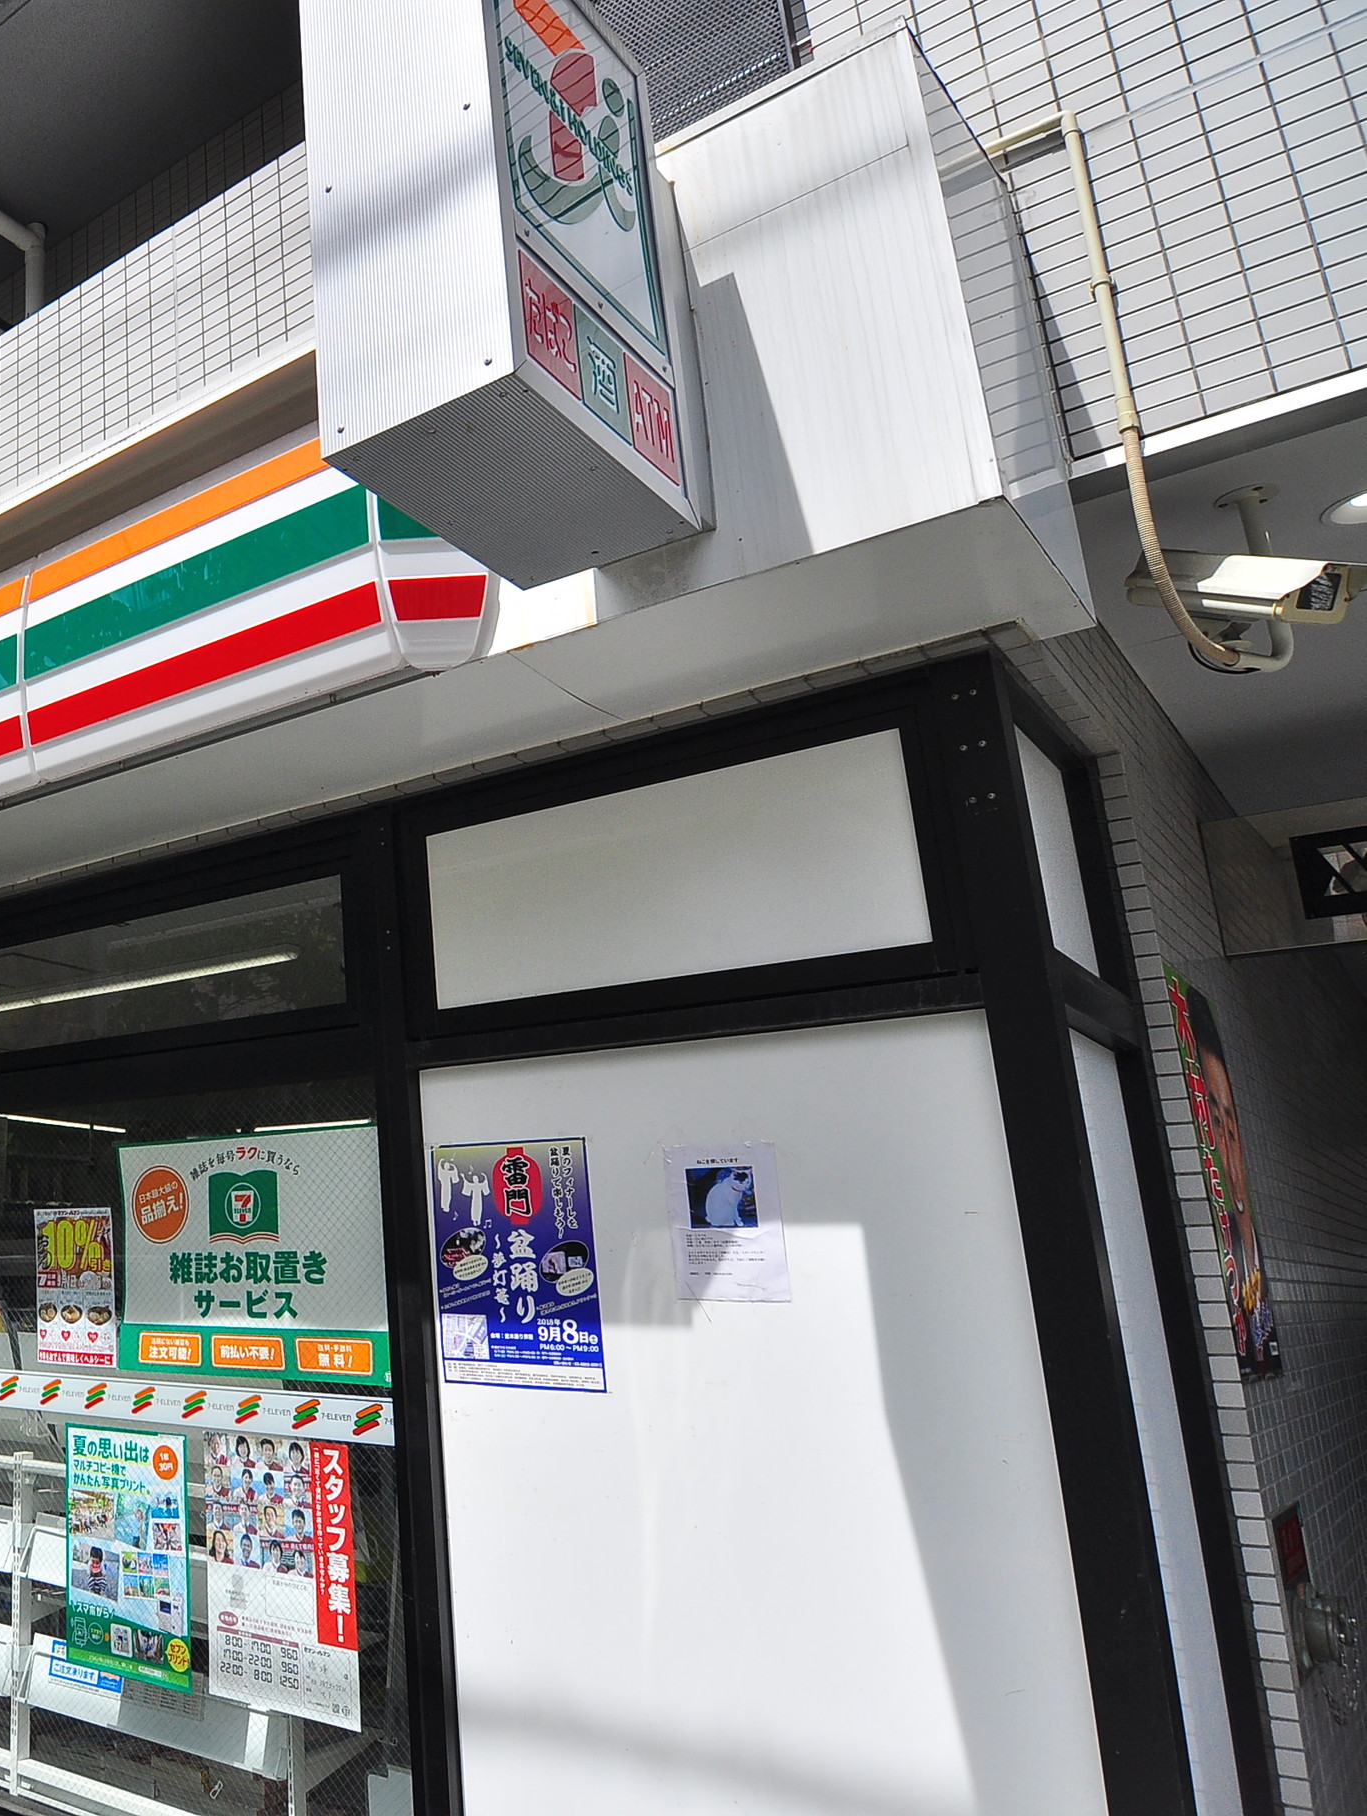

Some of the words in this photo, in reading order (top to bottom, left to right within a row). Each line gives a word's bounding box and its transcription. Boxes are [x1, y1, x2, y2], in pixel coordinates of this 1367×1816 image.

[587, 335, 620, 414] 酒
[633, 379, 675, 463] ATM
[501, 1156, 533, 1217] 雷門
[168, 1250, 329, 1285] 雑誌お取置き
[507, 1228, 539, 1325] 盆踊り
[193, 1289, 300, 1320] サービス
[537, 1318, 561, 1326] 2018年
[72, 1434, 150, 1464] 夏の思い出は
[73, 1458, 127, 1477] マルチコピー機で
[73, 1473, 151, 1495] かんたん写真プリント。
[322, 1448, 352, 1643] スタッフ募集!
[169, 1643, 187, 1655] セブン
[281, 1644, 299, 1661] 960
[280, 1660, 300, 1676] 960
